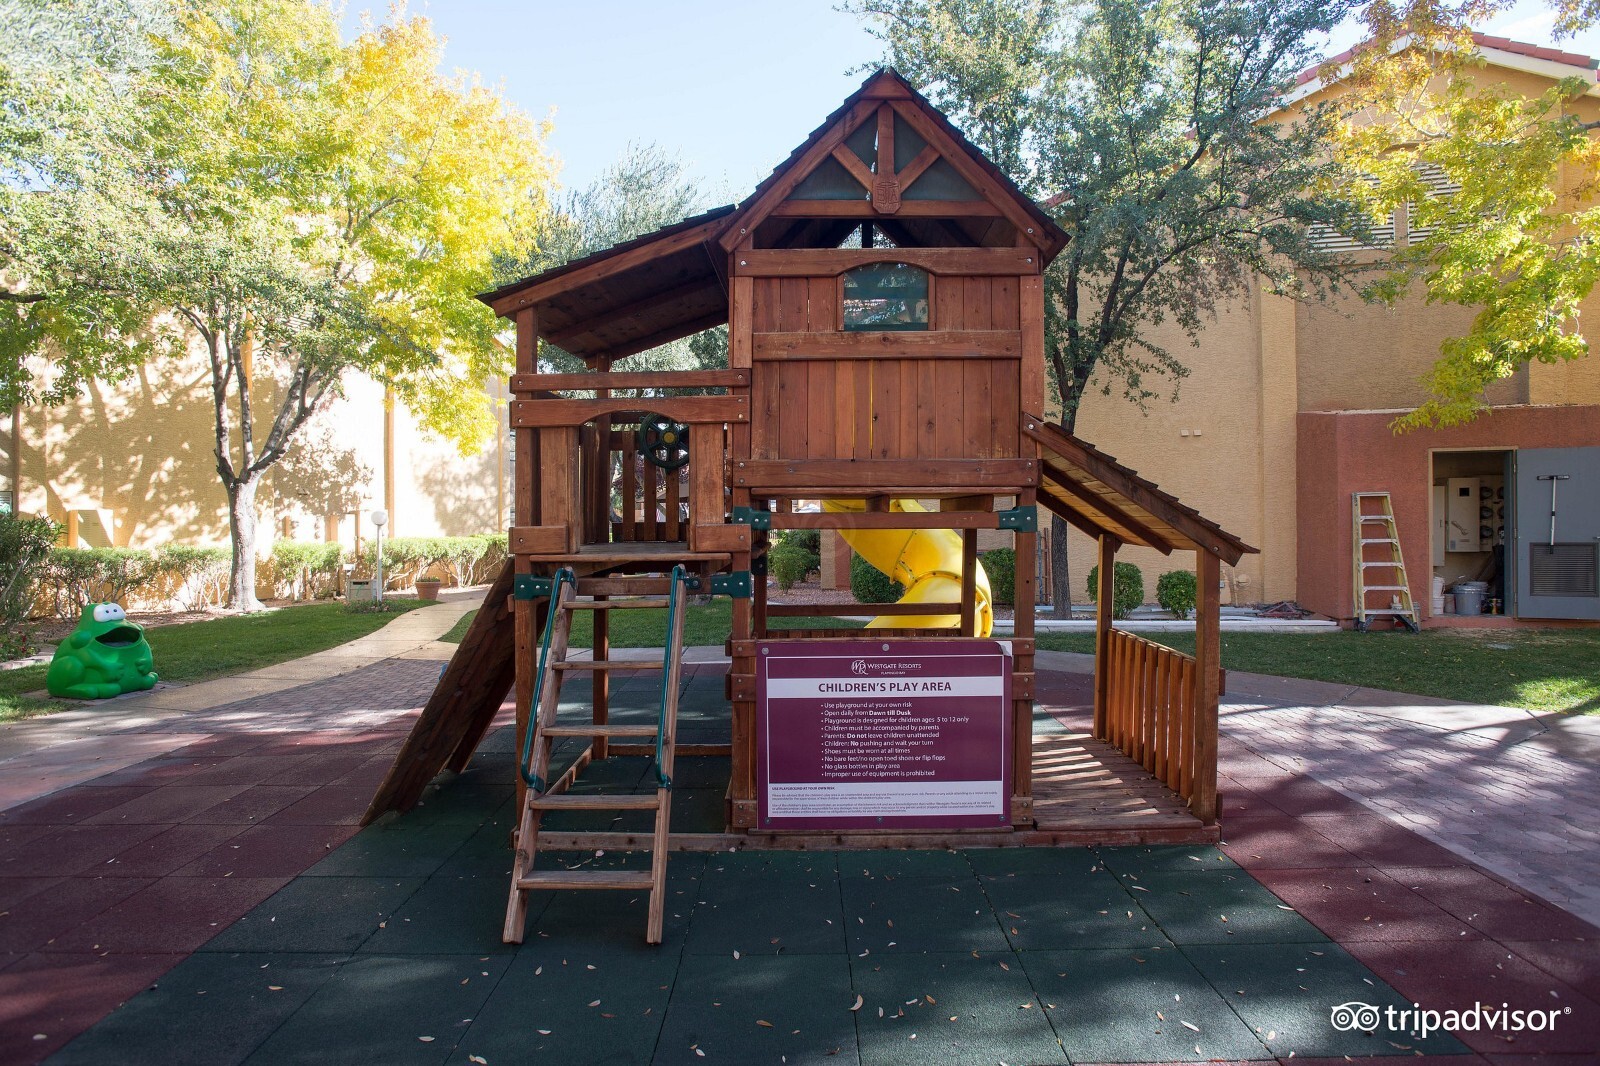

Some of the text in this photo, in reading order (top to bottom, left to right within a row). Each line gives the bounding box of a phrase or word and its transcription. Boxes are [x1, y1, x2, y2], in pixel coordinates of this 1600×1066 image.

[818, 682, 952, 692] CHILDREN'S PLAY AREA
